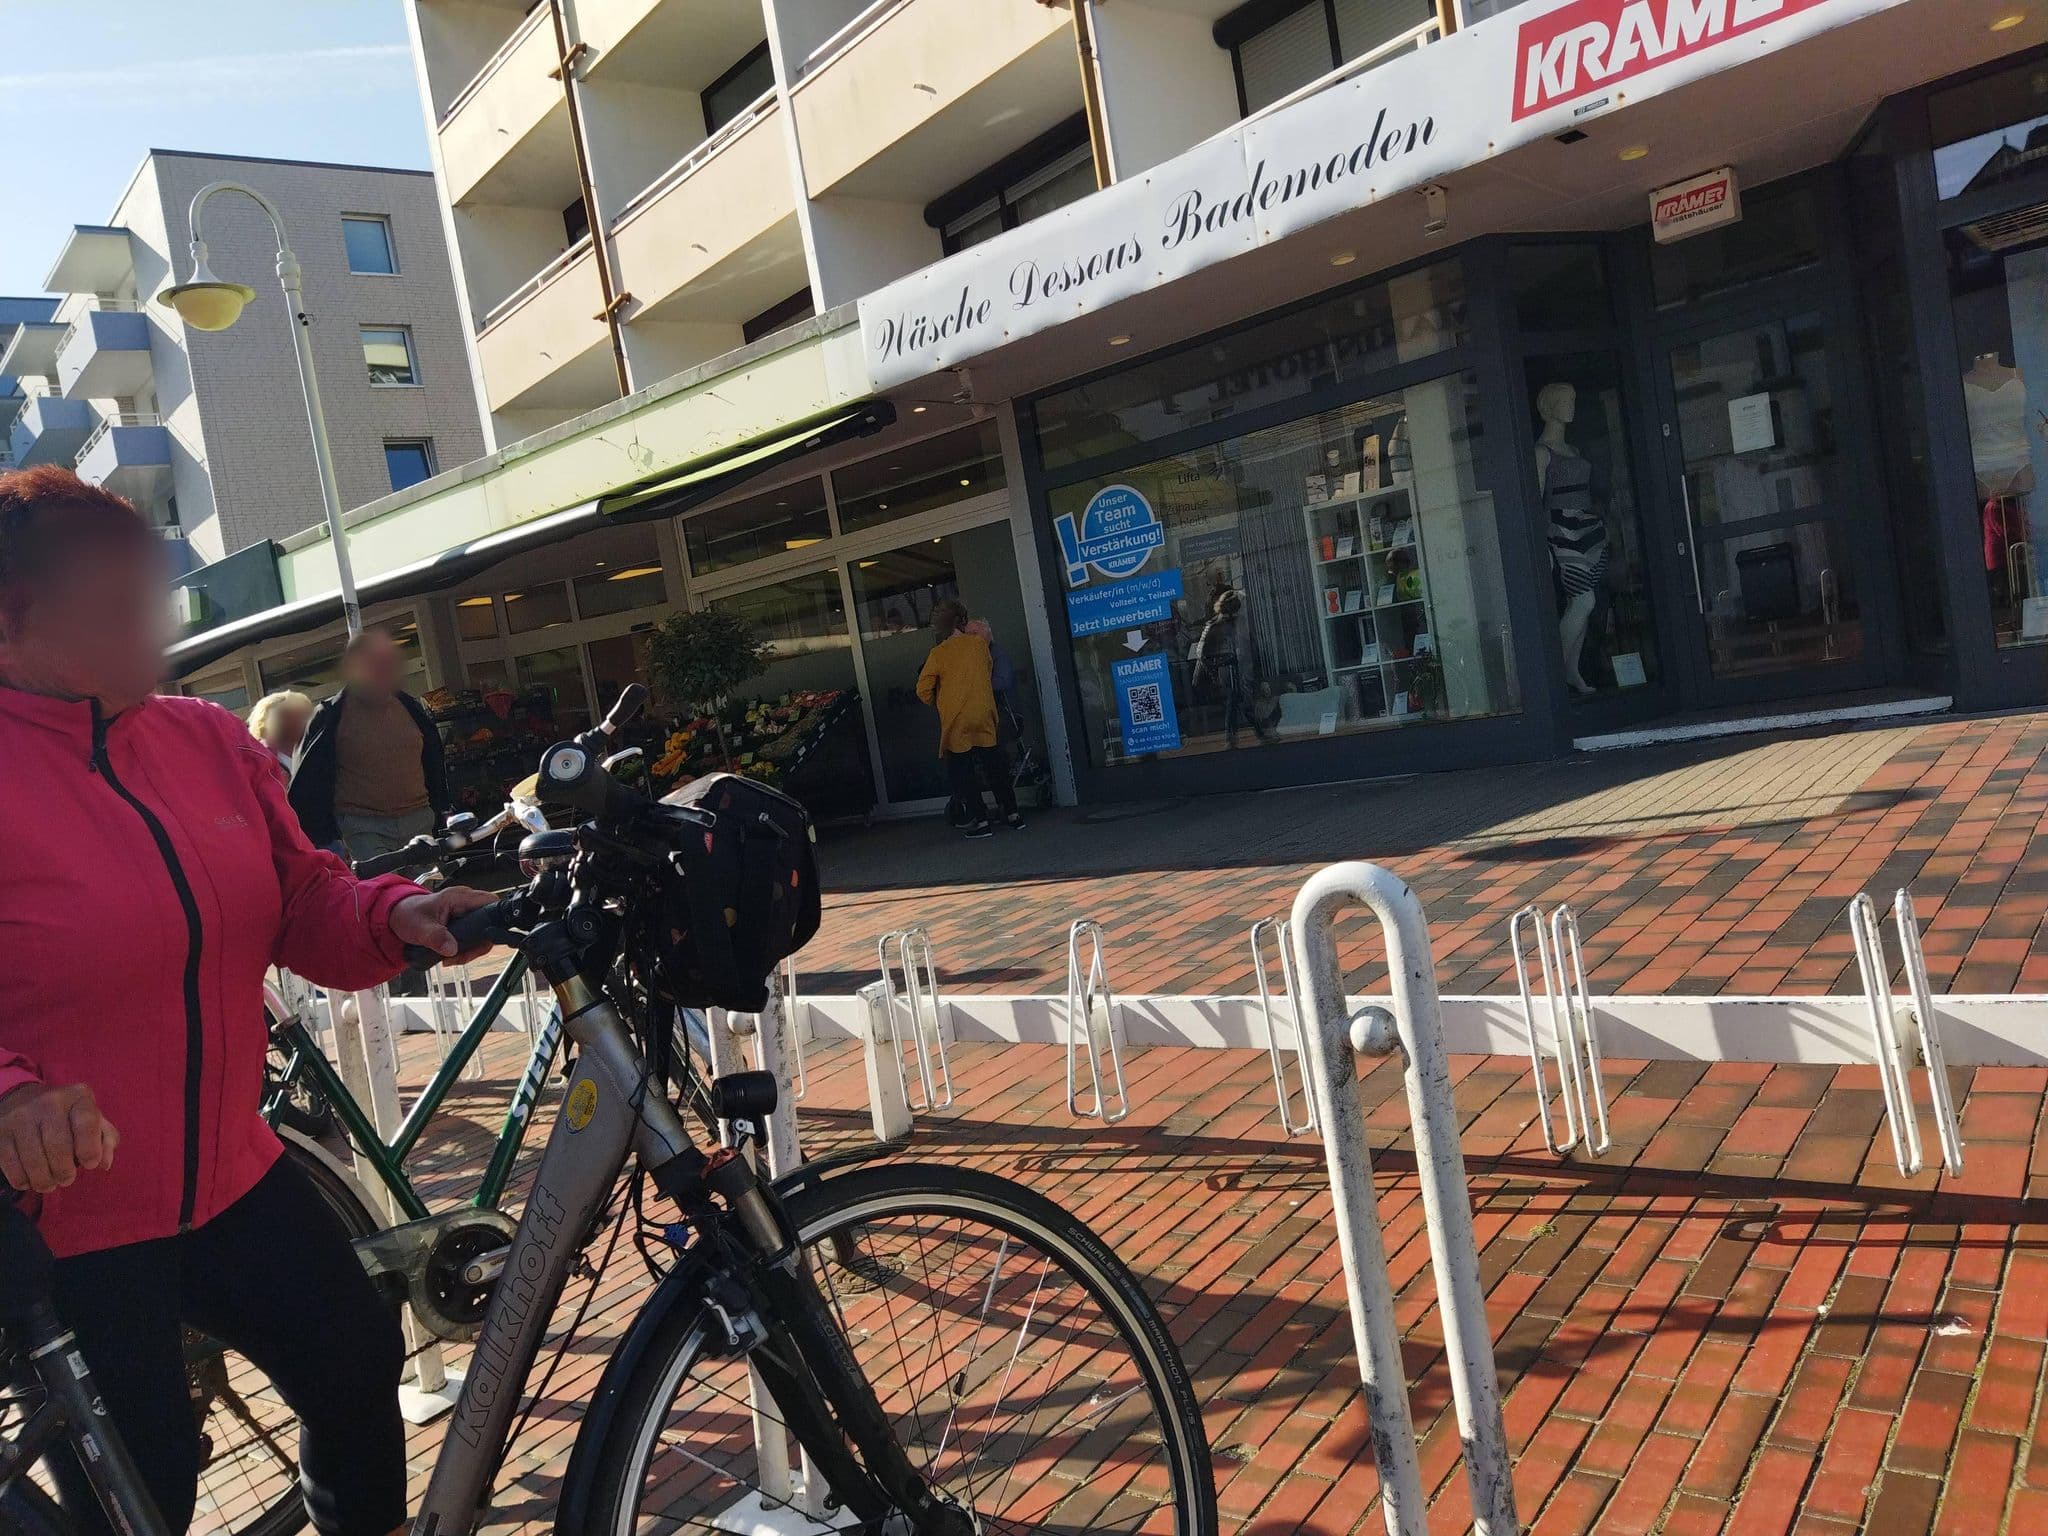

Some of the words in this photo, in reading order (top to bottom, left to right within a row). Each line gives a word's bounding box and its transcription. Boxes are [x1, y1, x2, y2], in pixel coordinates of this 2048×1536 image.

[874, 285, 991, 363] Wäsche
[1009, 232, 1143, 311] Dessous
[1162, 107, 1438, 249] Bademoden
[1178, 471, 1200, 484] Lifta
[1099, 494, 1128, 508] Unser
[1095, 505, 1136, 524] Team
[1103, 519, 1131, 534] sucht
[1080, 528, 1160, 558] Verstärkung!
[1108, 556, 1137, 569] KRÄMER
[1069, 586, 1124, 606] Verkäufer/in
[1126, 578, 1161, 593] (m/w/d)
[1109, 597, 1137, 609] Vollzeit
[1148, 588, 1176, 601] Teilzeit
[1073, 620, 1100, 634] Jetzt
[1103, 606, 1162, 627] bewerben!
[1117, 658, 1162, 676] KRÄMER
[1131, 725, 1148, 734] scan
[1067, 1226, 1122, 1277] SCHWALBE
[1179, 1389, 1196, 1425] PLUS
